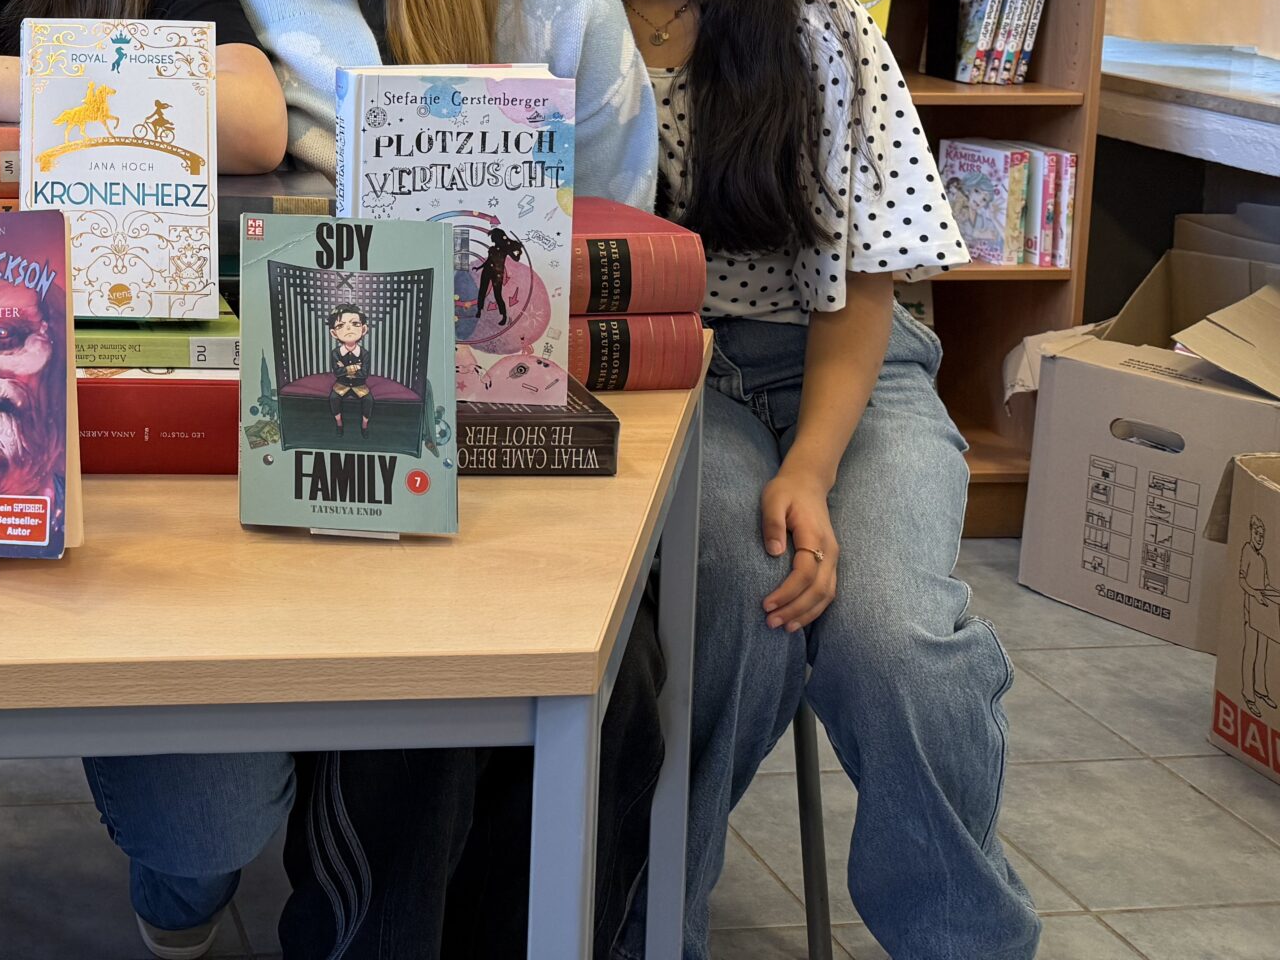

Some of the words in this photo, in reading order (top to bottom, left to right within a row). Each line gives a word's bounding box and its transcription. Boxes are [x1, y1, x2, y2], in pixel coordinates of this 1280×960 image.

[71, 53, 108, 63] ROYAL
[129, 54, 174, 65] HORSES
[383, 91, 441, 108] Stefanie
[373, 127, 557, 158] PLÖTZLICH
[4, 160, 13, 174] JM
[88, 161, 115, 172] JANA
[121, 162, 154, 172] HOCH
[946, 148, 996, 169] KAMISAMA
[364, 159, 565, 198] VERTAUSCHT
[34, 181, 208, 208] KRONENHERZ
[315, 222, 373, 270] SPY
[86, 343, 99, 352] der
[100, 343, 127, 352] Stimme
[128, 343, 141, 352] Die
[197, 345, 207, 362] DU
[98, 353, 127, 363] Andrea
[465, 426, 498, 446] HER
[504, 426, 547, 446] SHOT
[551, 426, 574, 446] HE
[502, 448, 547, 469] CAME
[551, 448, 600, 469] WHAT
[294, 450, 397, 505] FAMILY
[414, 477, 421, 488] 7
[13, 503, 45, 513] SPIEGEL
[310, 504, 354, 516] TATSUYA
[356, 507, 383, 517] ENDO
[6, 526, 31, 536] Autor
[1106, 588, 1172, 620] BAUHAUS
